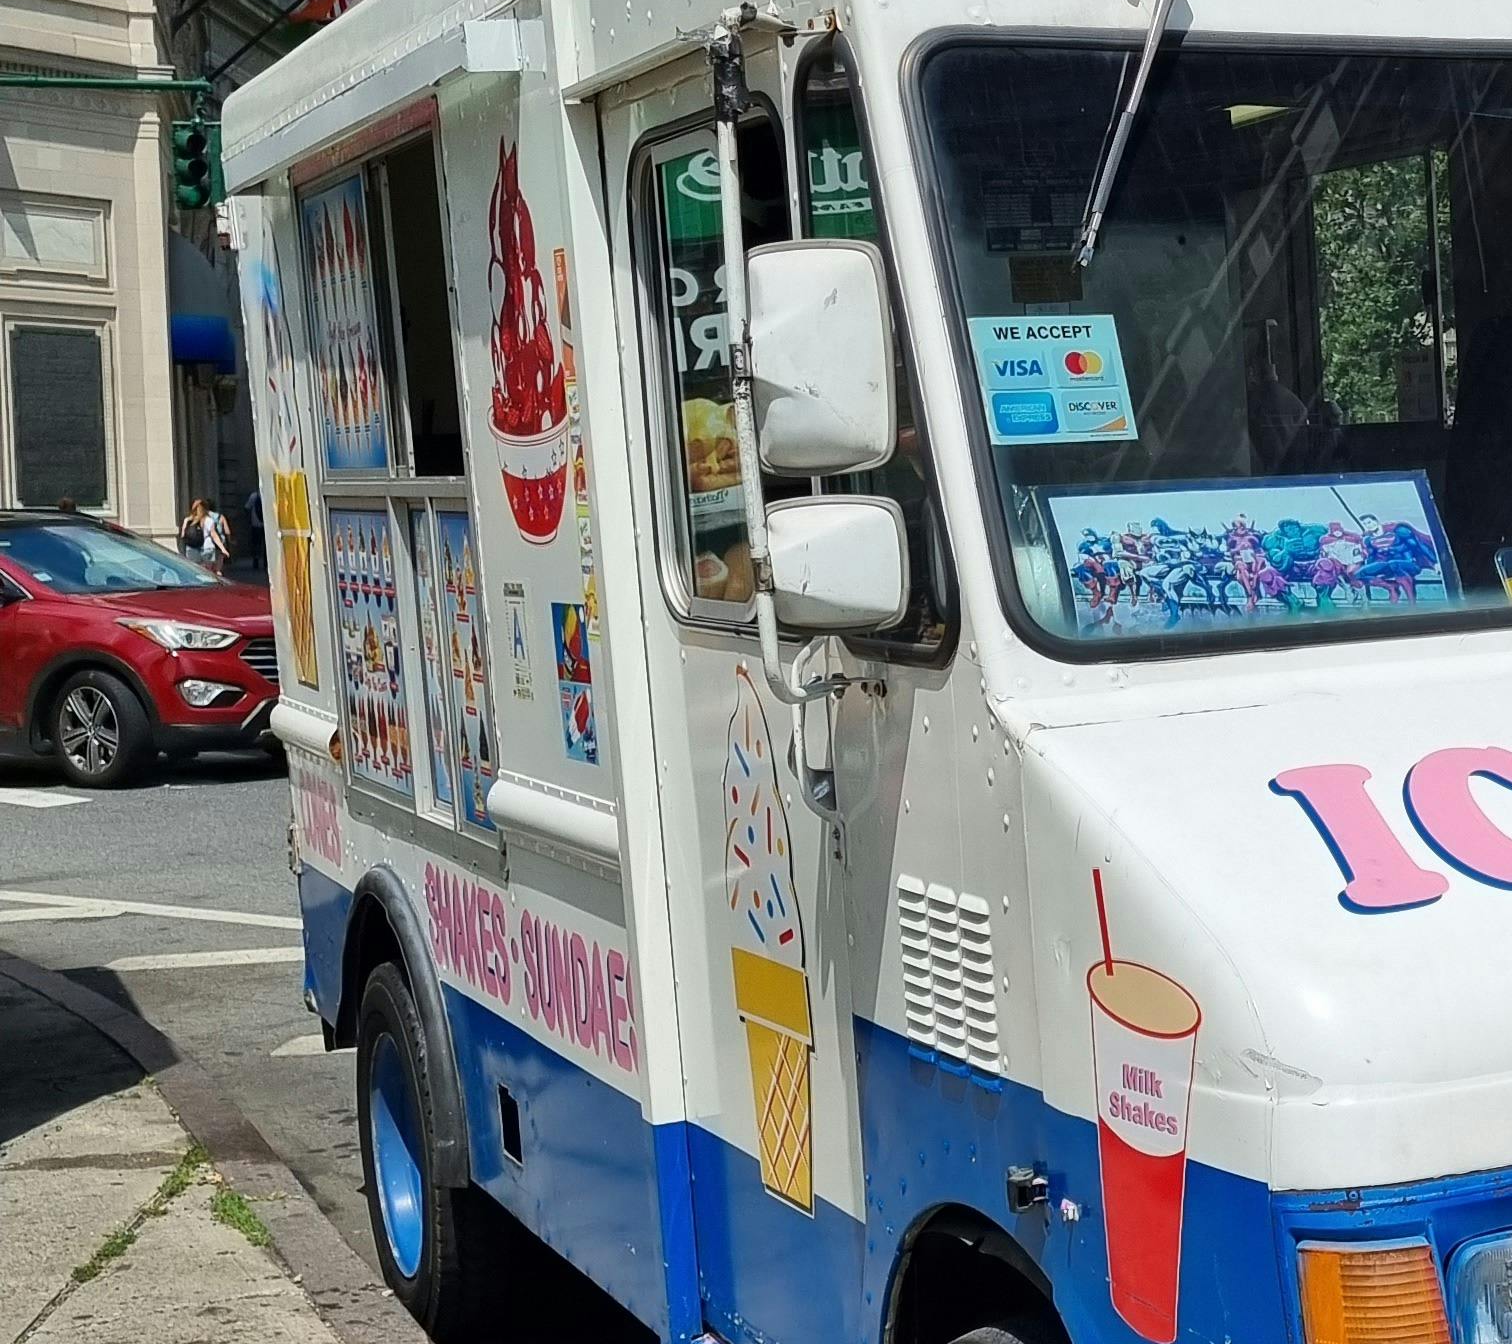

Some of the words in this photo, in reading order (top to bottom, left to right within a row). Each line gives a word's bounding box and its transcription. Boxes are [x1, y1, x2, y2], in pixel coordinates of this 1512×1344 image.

[993, 326, 1021, 340] WE
[1026, 325, 1092, 339] ACCEPT
[994, 359, 1043, 377] VISA
[424, 861, 511, 1006] SHAKES
[1121, 1062, 1163, 1099] Milk
[1108, 1089, 1179, 1137] Shakes
